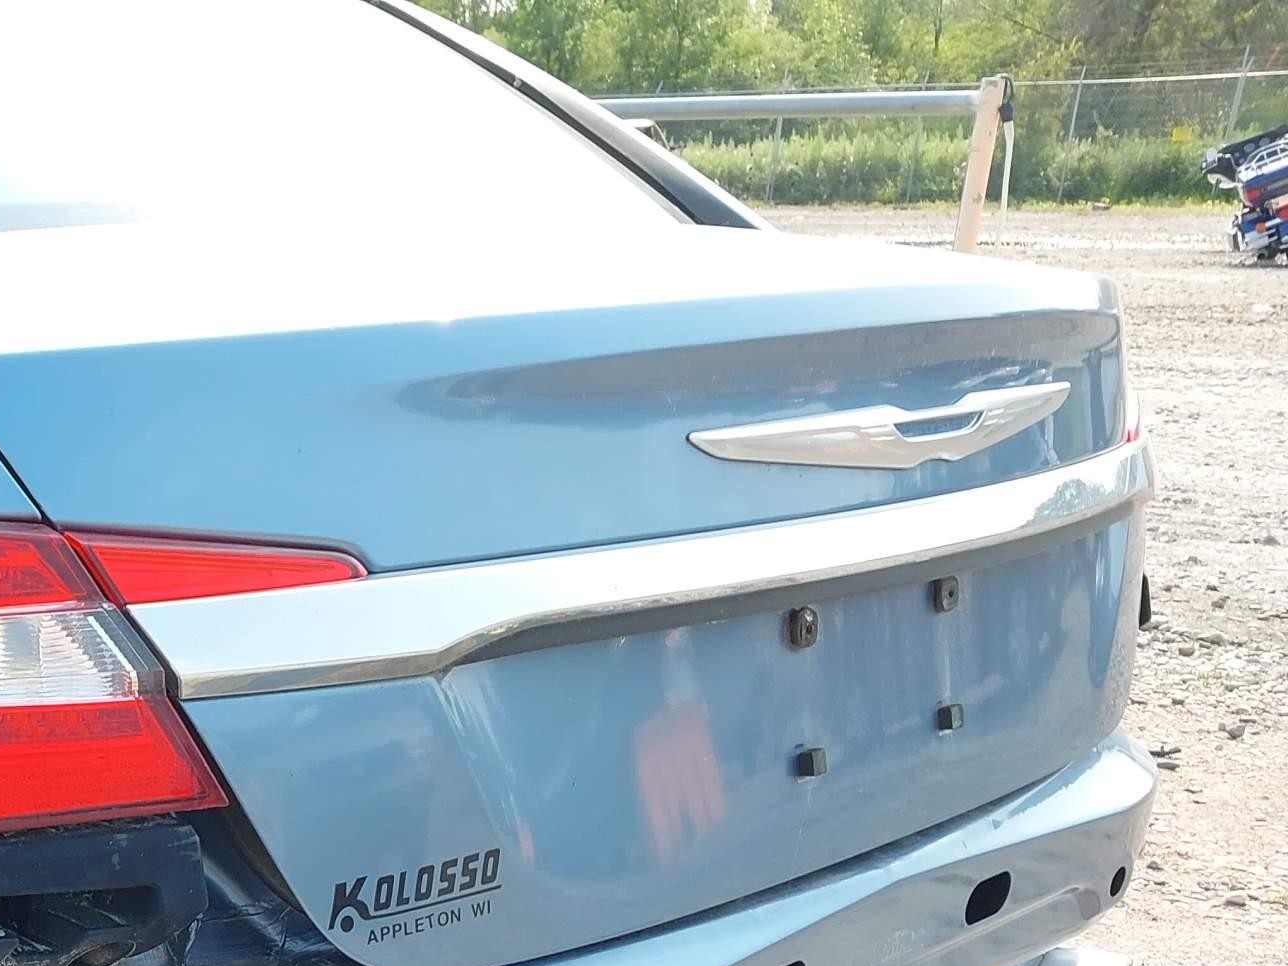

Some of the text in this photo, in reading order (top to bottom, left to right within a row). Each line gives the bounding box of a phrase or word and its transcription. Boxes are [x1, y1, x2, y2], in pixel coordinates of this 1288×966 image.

[328, 848, 501, 931] KOLOSSO
[367, 899, 491, 945] APPLETON WI
